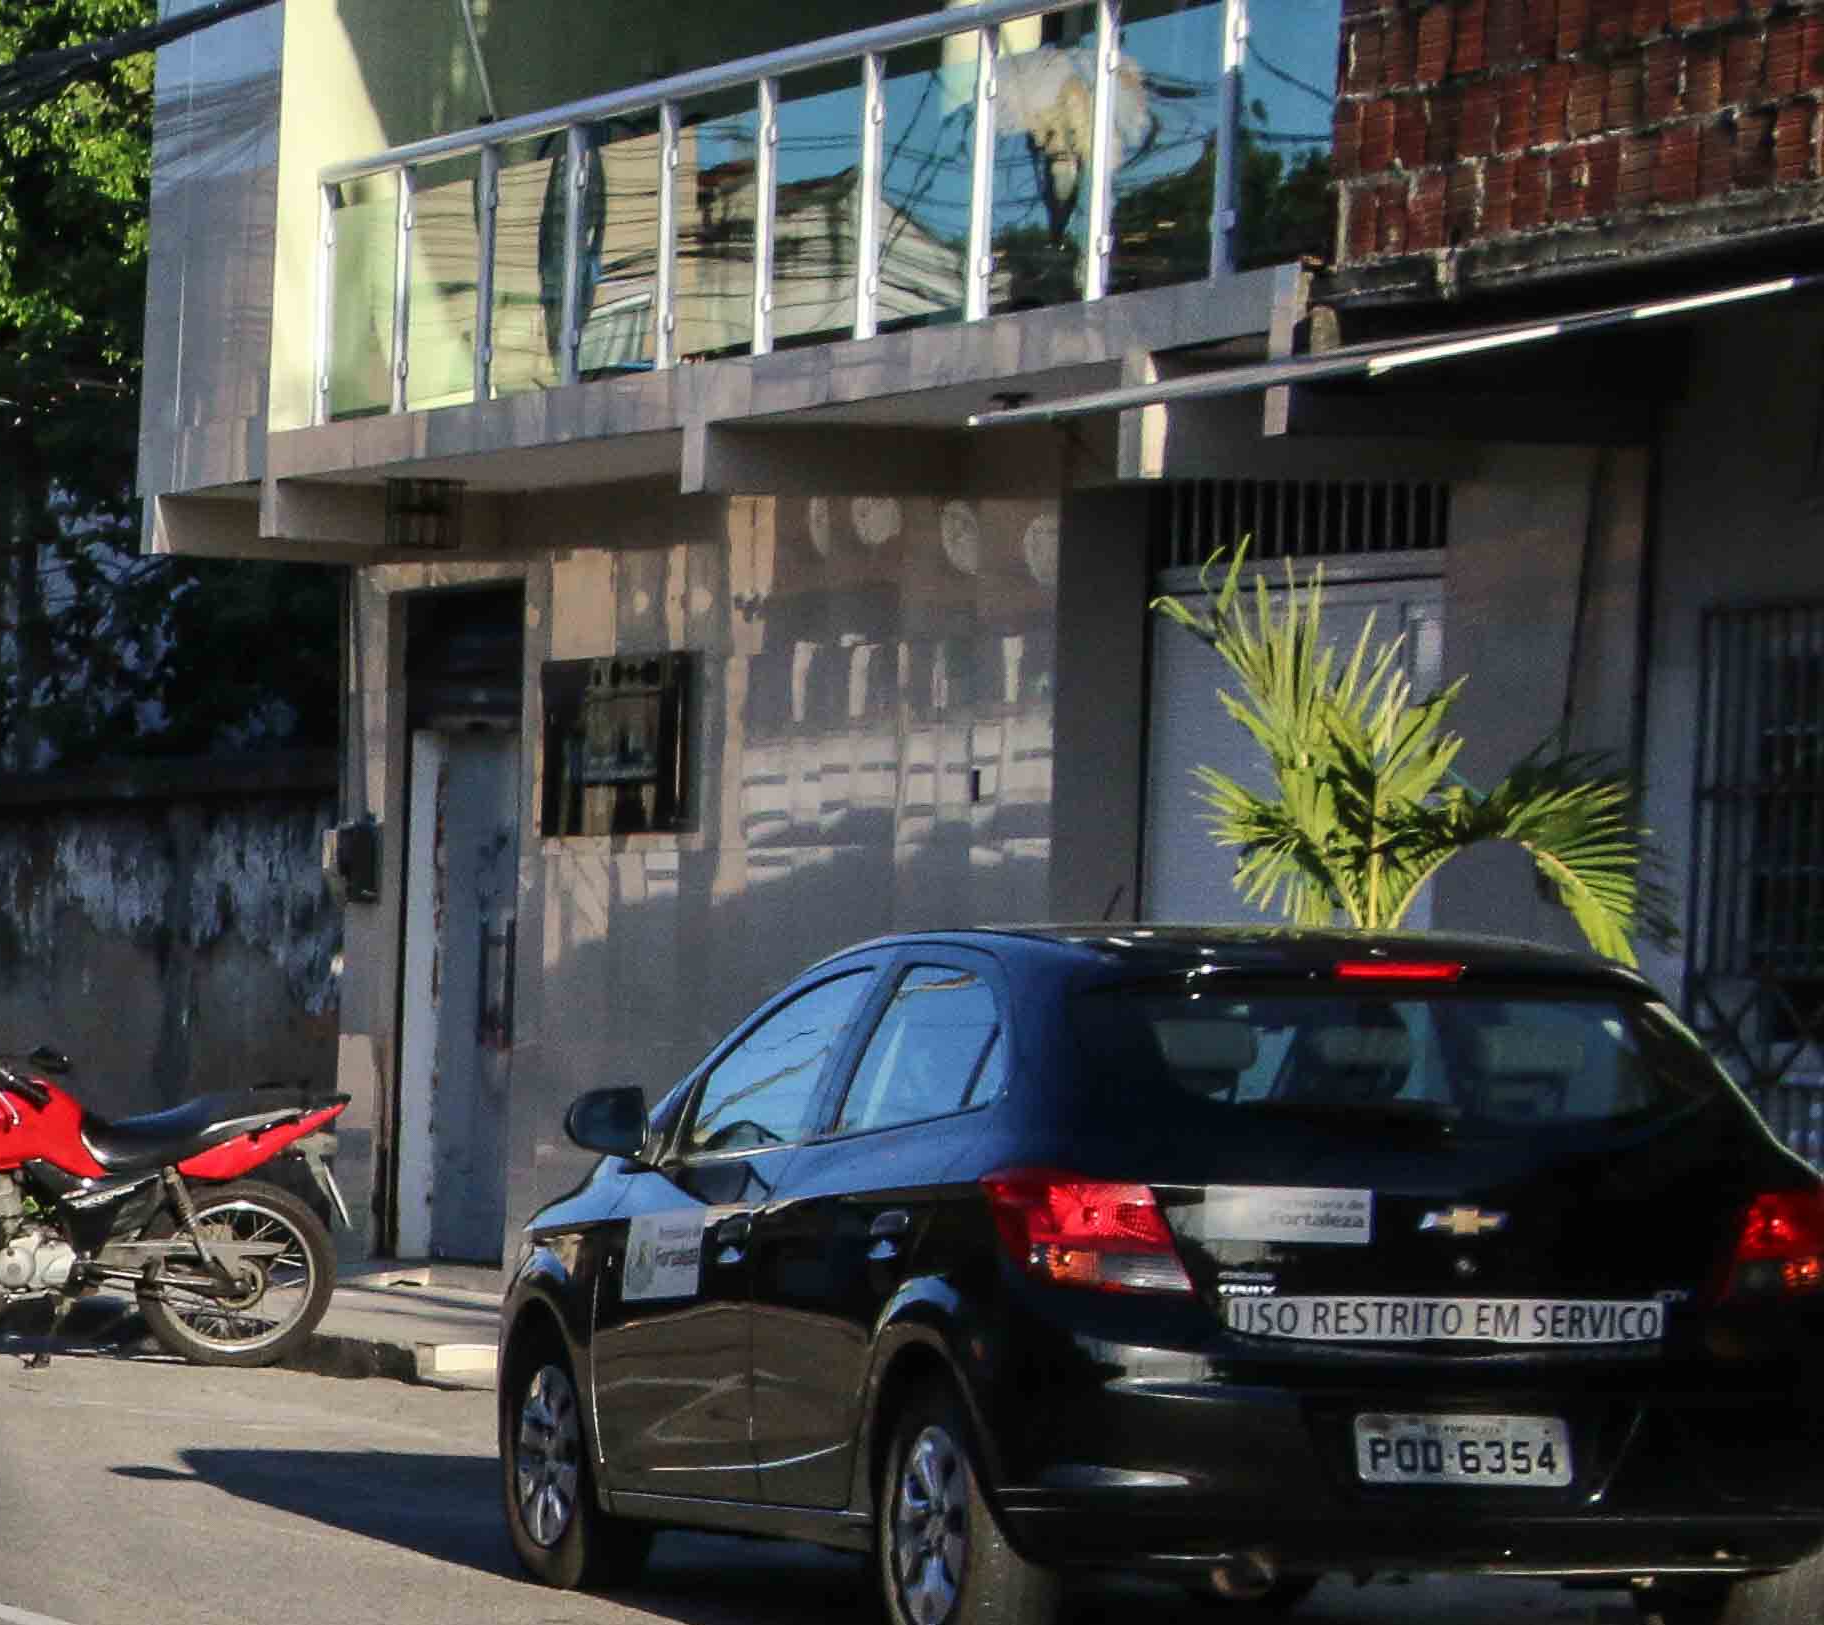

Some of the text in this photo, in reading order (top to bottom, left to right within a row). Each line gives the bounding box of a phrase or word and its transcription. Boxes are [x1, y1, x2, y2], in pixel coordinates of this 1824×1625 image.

[1233, 1302, 1298, 1335] USO
[1312, 1302, 1462, 1335] RESTRITO
[1475, 1303, 1520, 1337] EM
